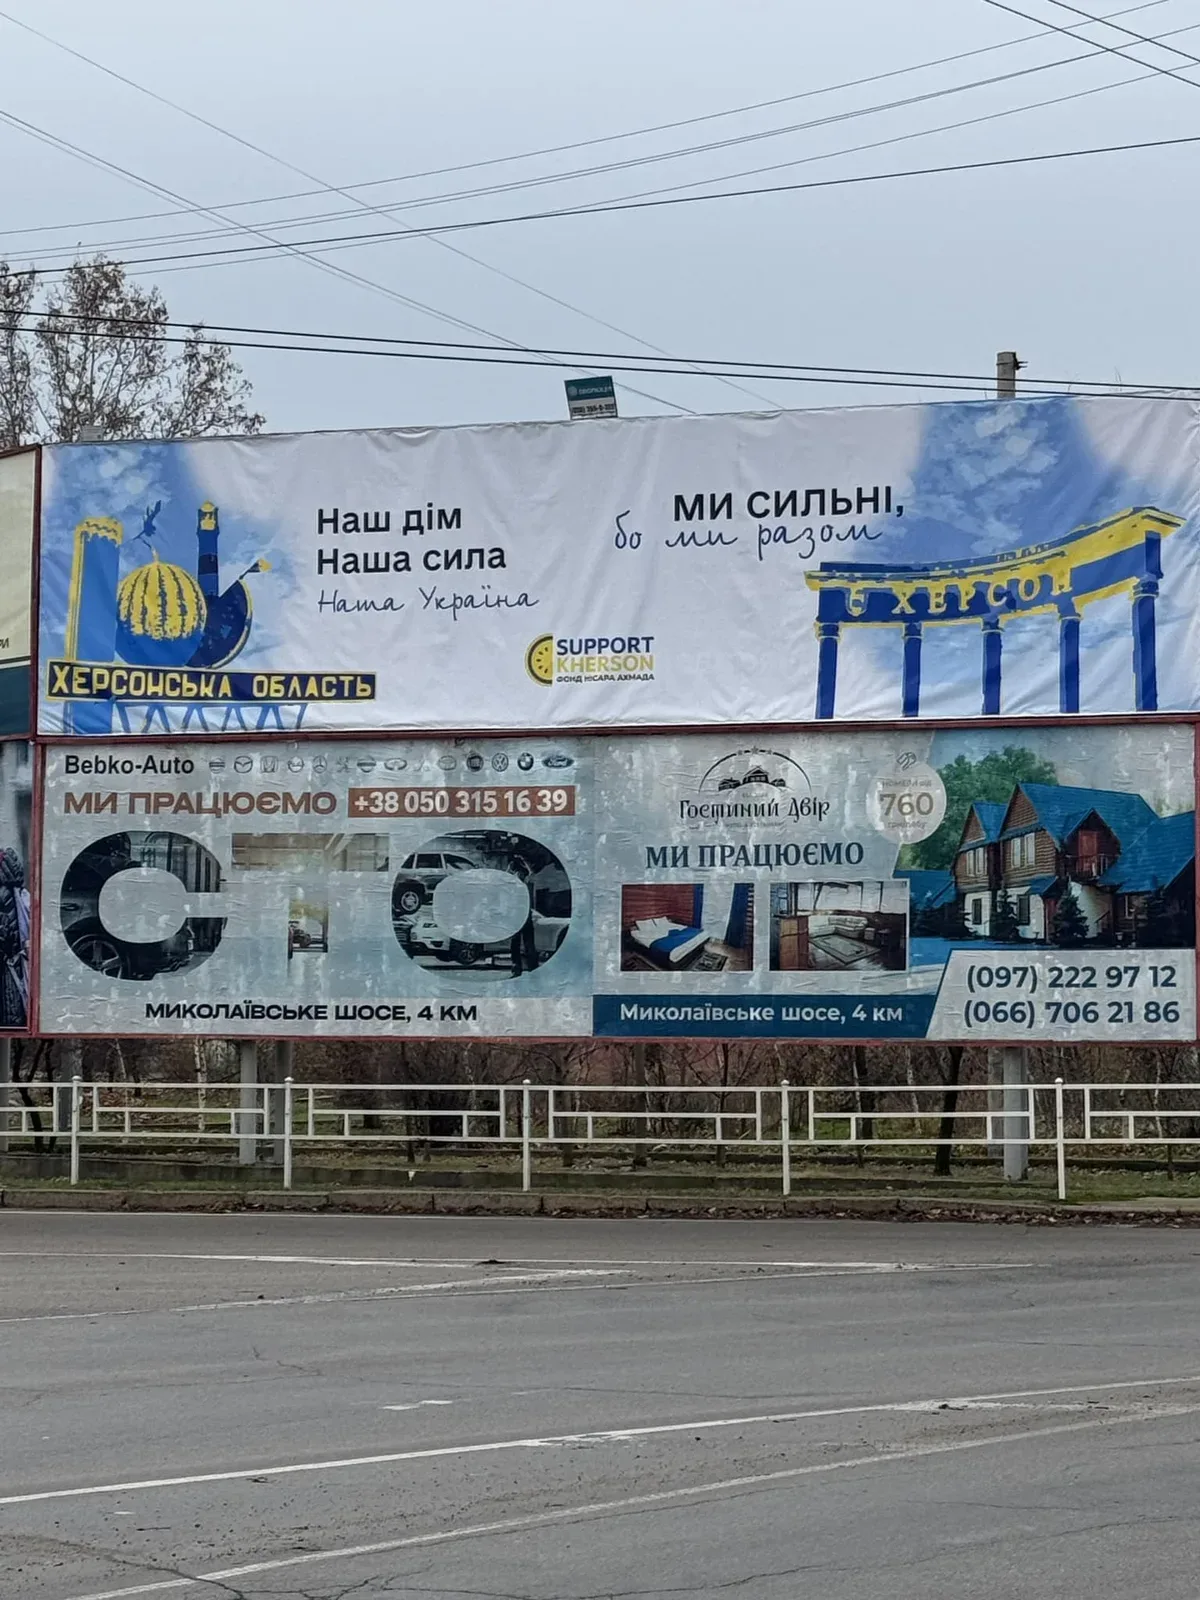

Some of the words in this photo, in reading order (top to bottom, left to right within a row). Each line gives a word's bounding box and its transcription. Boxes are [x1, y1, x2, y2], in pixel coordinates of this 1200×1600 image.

[317, 508, 391, 535] Наш
[402, 502, 462, 536] дім
[673, 492, 733, 521] МИ
[614, 510, 643, 549] бо
[665, 529, 739, 547] ми
[758, 523, 883, 561] разом
[317, 548, 412, 575] Наша
[422, 546, 507, 571] сила
[418, 585, 540, 621] Україна
[556, 636, 655, 656] SUPPORT
[556, 655, 655, 673] KHERSON
[616, 673, 655, 682] АХМАДА
[51, 664, 232, 698] ХЕРСОНСЬКА
[252, 675, 372, 698] ОБЛАСТЬ
[64, 755, 195, 775] Bebko-Auto
[63, 792, 119, 815] МИ
[128, 791, 338, 819] ПРАЦЮЄМО
[354, 791, 400, 814] +38
[404, 790, 450, 814] 050
[455, 790, 498, 813] 315
[503, 790, 531, 813] 16
[536, 789, 568, 813] 39
[680, 797, 780, 825] Гостиний
[787, 796, 831, 823] Двір
[880, 792, 934, 816] 760
[645, 846, 690, 869] МИ
[698, 842, 865, 872] ПРАЦЮЄМО
[967, 965, 1038, 994] (097)
[1048, 966, 1098, 989] 222
[1105, 966, 1141, 989] 97
[1149, 966, 1177, 988] 12
[145, 999, 329, 1020] МИКОЛАЇВСЬКЕ
[334, 1004, 412, 1022] ШОСЕ,
[417, 1005, 434, 1020] 4
[440, 1004, 478, 1021] КМ
[620, 1003, 775, 1022] Миколаївське
[781, 1005, 847, 1025] шосе,
[852, 1005, 868, 1021] 4
[873, 1006, 904, 1021] км
[964, 1000, 1036, 1029] (066)
[1045, 1001, 1100, 1024] 706
[1107, 1001, 1134, 1024] 21
[1143, 1001, 1180, 1024] 86
